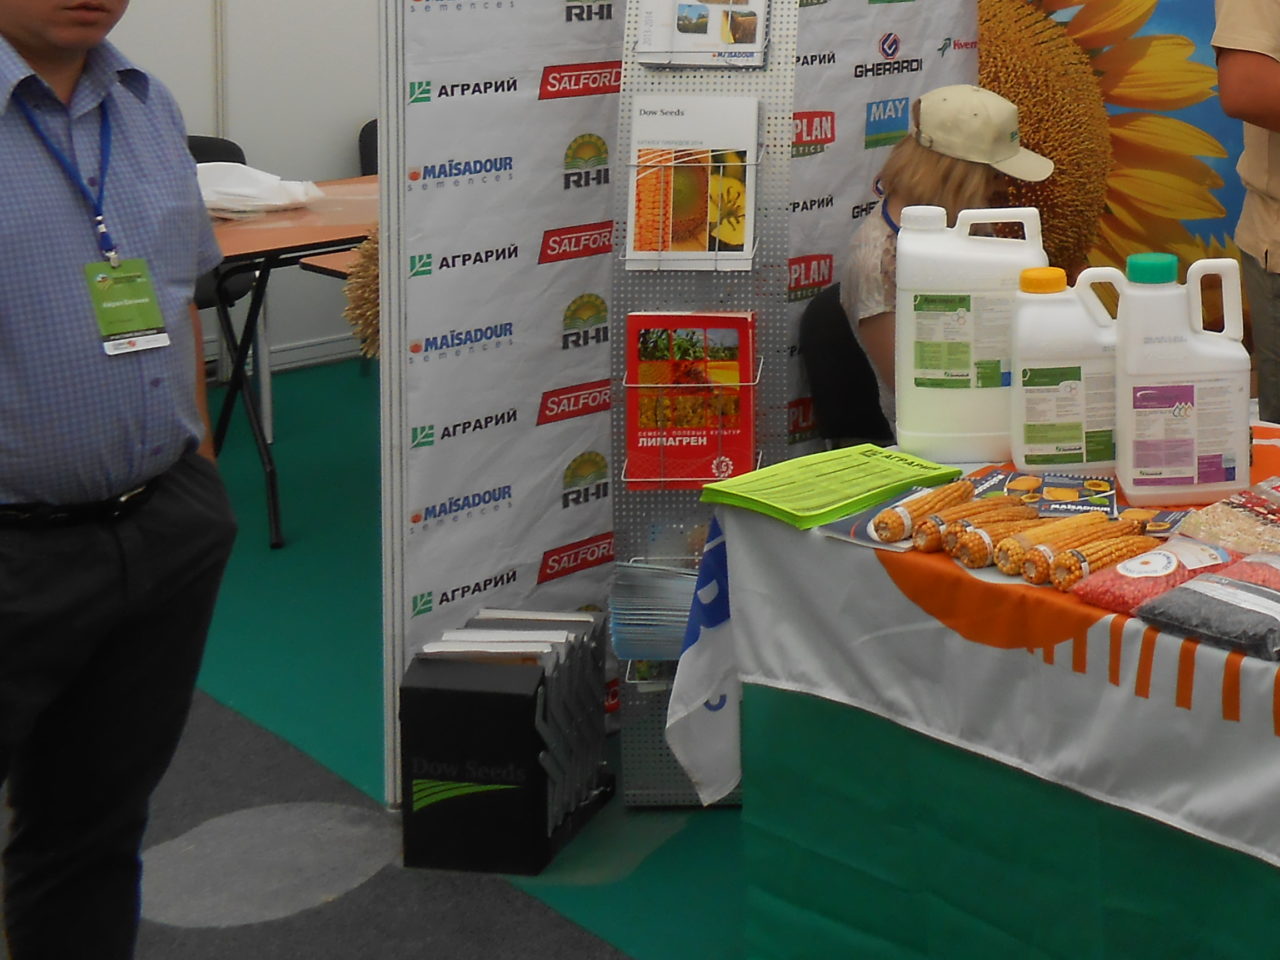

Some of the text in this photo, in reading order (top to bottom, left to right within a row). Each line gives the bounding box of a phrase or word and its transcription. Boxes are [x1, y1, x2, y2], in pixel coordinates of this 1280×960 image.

[566, 3, 613, 22] RHI
[854, 58, 922, 78] GHERARDI
[438, 79, 518, 98] АГРАРИЙ
[870, 100, 906, 122] MAY
[422, 156, 513, 180] MAÏSADOUR
[564, 168, 609, 190] RHI
[547, 228, 613, 256] SALFOR
[438, 244, 518, 270] АГРАРИЙ
[423, 322, 513, 352] MAÏSADOUR
[562, 326, 609, 350] RHI
[546, 386, 610, 416] SALFOR
[441, 408, 517, 440] АГРАРИЙ
[423, 485, 512, 520] MAÏSADOUR
[562, 481, 609, 510] RHI
[439, 569, 517, 606] АГРАРИЙ
